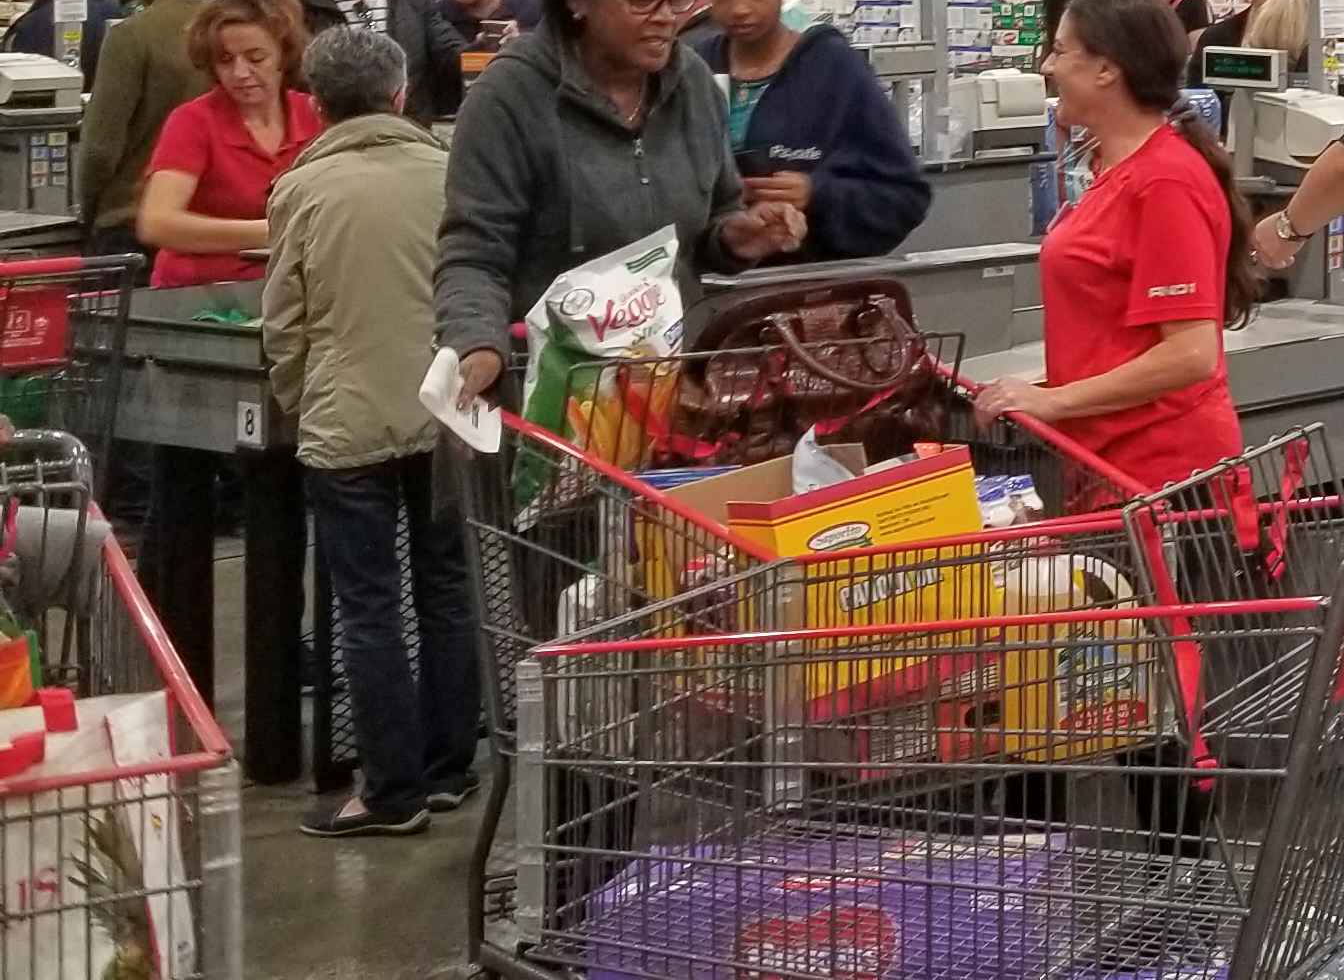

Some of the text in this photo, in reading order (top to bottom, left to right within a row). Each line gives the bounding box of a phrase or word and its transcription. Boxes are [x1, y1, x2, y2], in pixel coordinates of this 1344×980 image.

[587, 284, 666, 342] Veggie
[246, 409, 254, 435] 8
[840, 569, 914, 612] CANOLA
